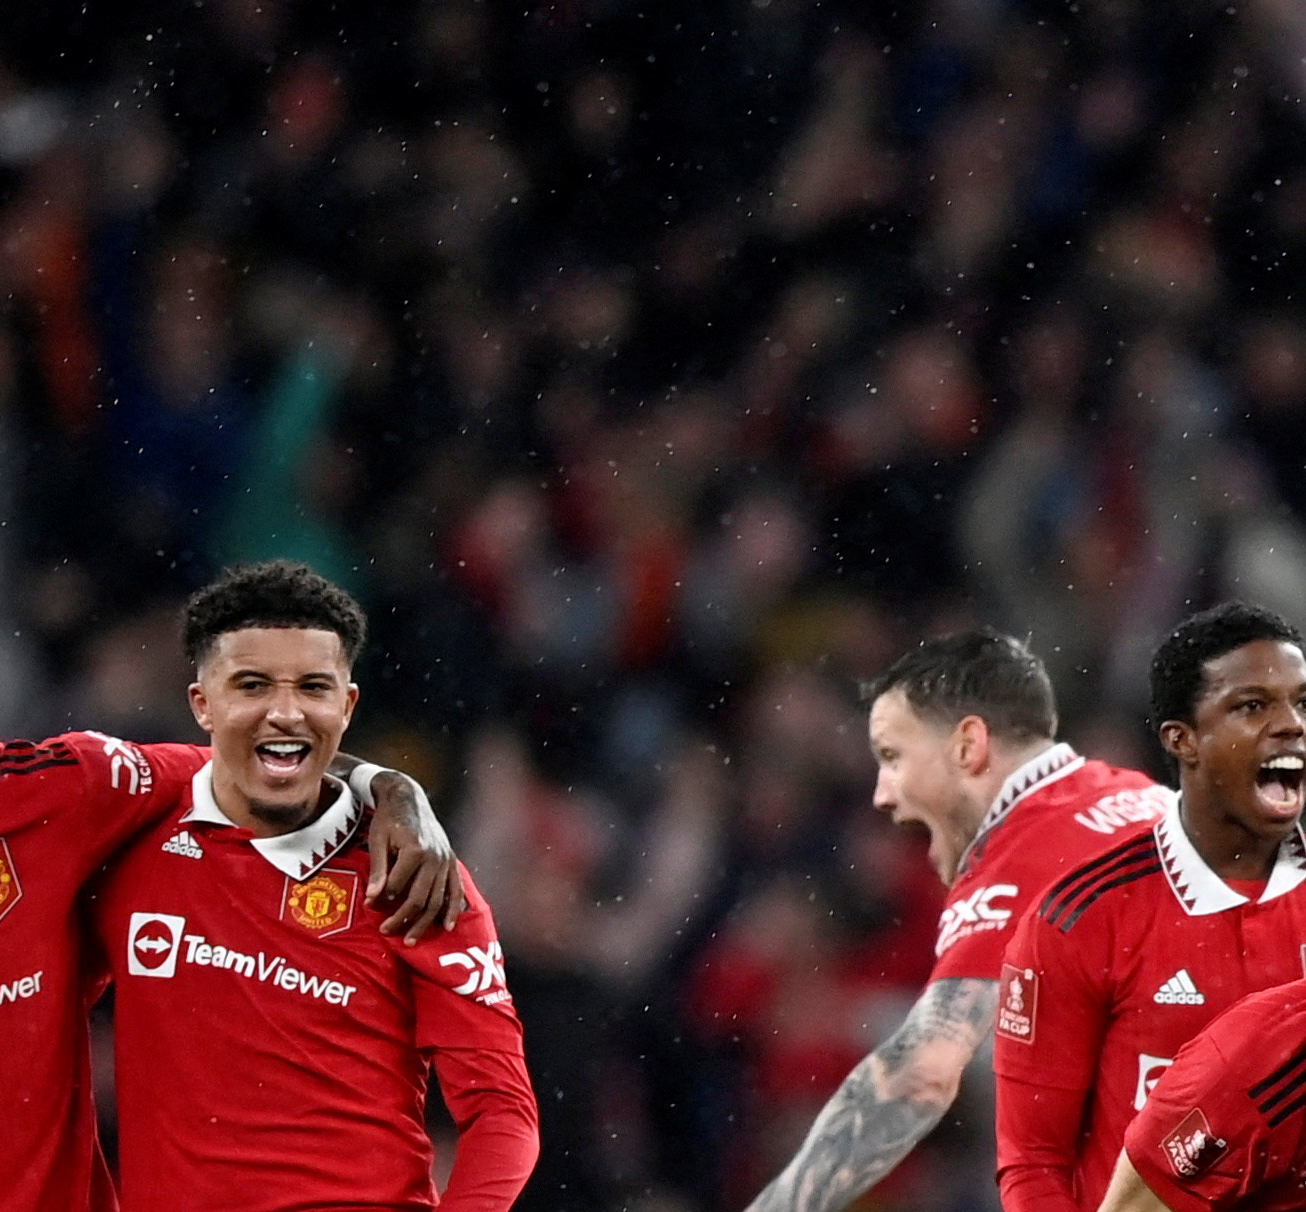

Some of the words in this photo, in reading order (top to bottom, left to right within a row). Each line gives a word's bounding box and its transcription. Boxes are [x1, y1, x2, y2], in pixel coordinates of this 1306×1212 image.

[161, 839, 203, 860] adidas
[183, 934, 356, 1008] TeamViewer
[1154, 991, 1205, 1006] adidas
